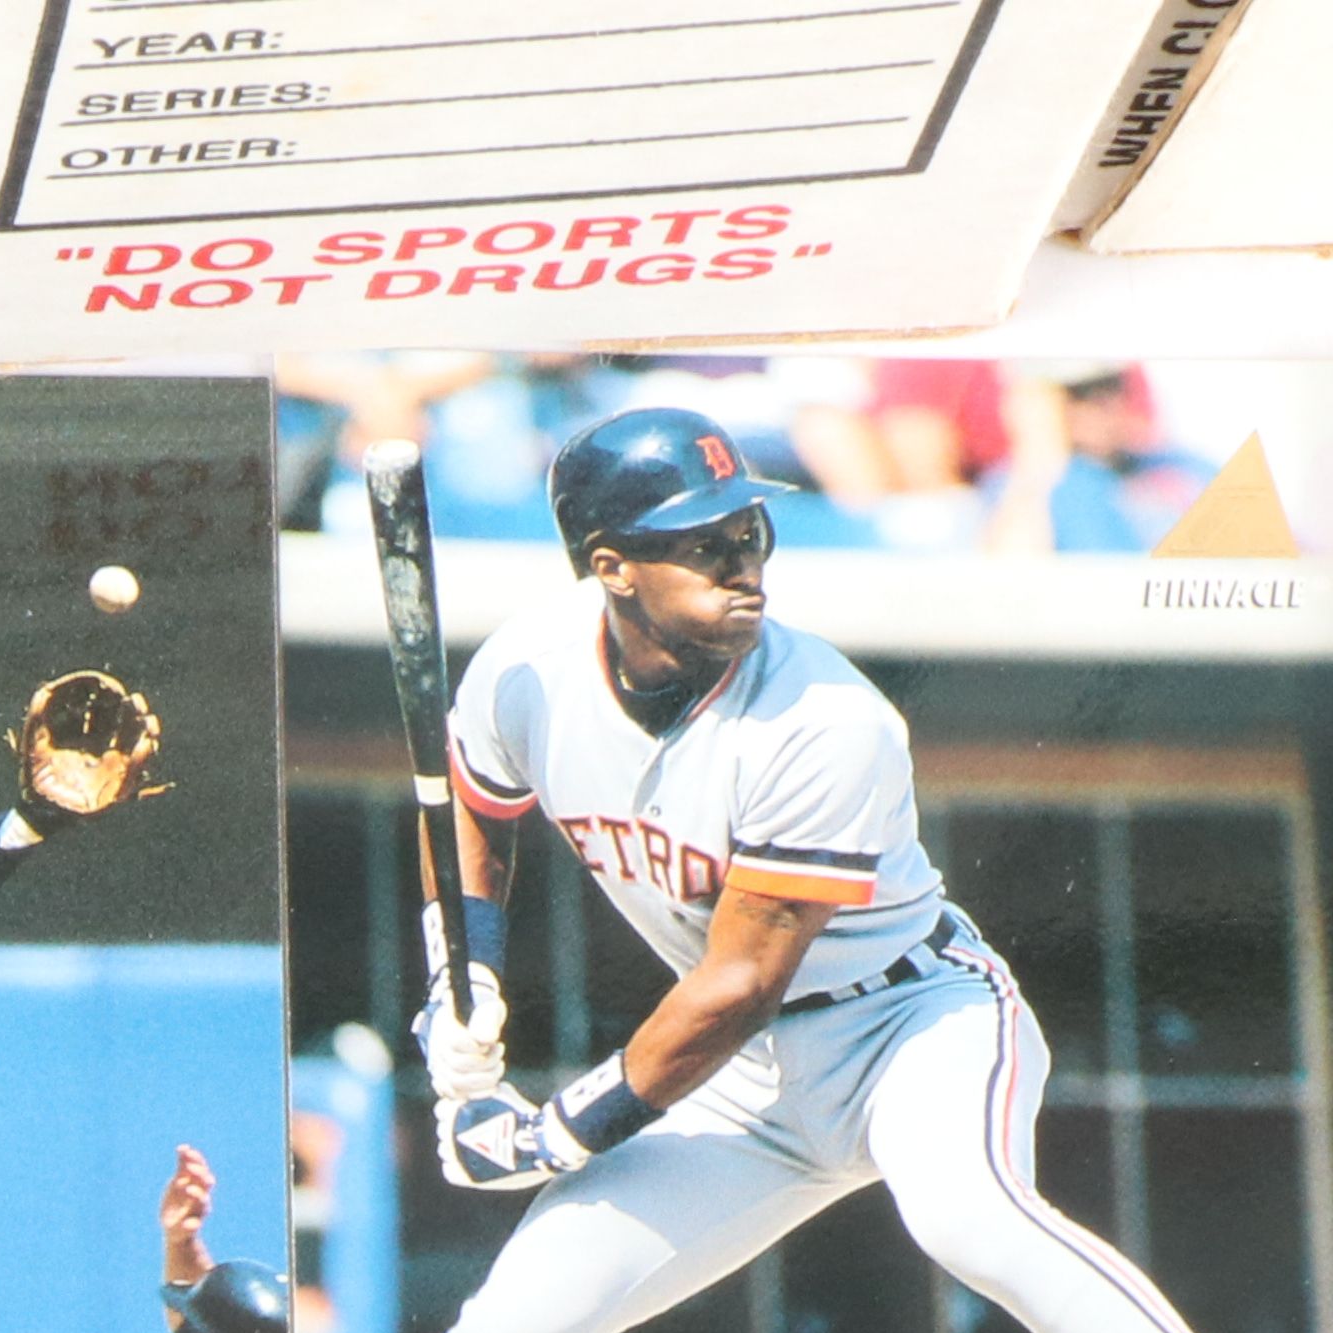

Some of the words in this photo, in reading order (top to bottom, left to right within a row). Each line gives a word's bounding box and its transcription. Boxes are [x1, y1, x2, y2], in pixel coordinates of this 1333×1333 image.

[93, 29, 285, 59] YEAR:
[77, 82, 332, 117] SERIES:
[60, 137, 297, 170] OTHER:
[55, 238, 275, 277] "DO
[312, 203, 795, 266] SPORTS
[84, 273, 334, 313] NOT
[364, 242, 835, 301] DRUGS"
[1141, 579, 1303, 609] PINNACLE
